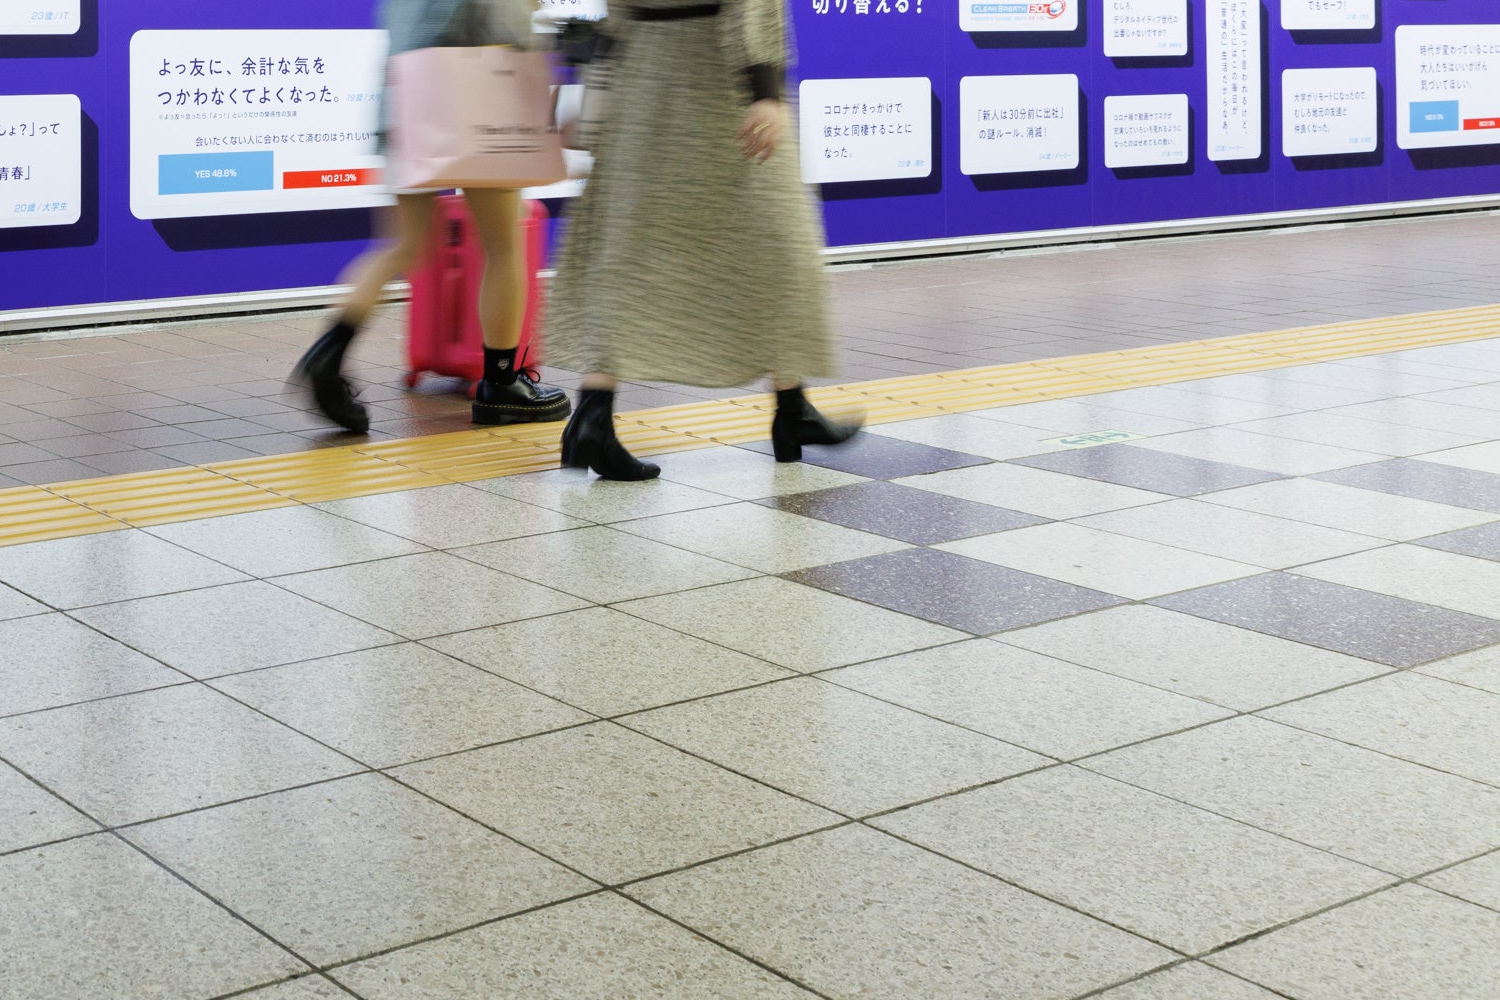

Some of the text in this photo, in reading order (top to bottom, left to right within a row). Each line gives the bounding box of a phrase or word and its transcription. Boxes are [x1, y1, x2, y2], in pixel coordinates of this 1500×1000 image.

[157, 56, 326, 77] よっ友に、余計な気を
[157, 84, 340, 106] つかわなくてよくなった。
[823, 103, 902, 115] コロナがきっかけで
[823, 146, 853, 159] なった。
[195, 170, 211, 179] YES
[321, 174, 333, 183] NO
